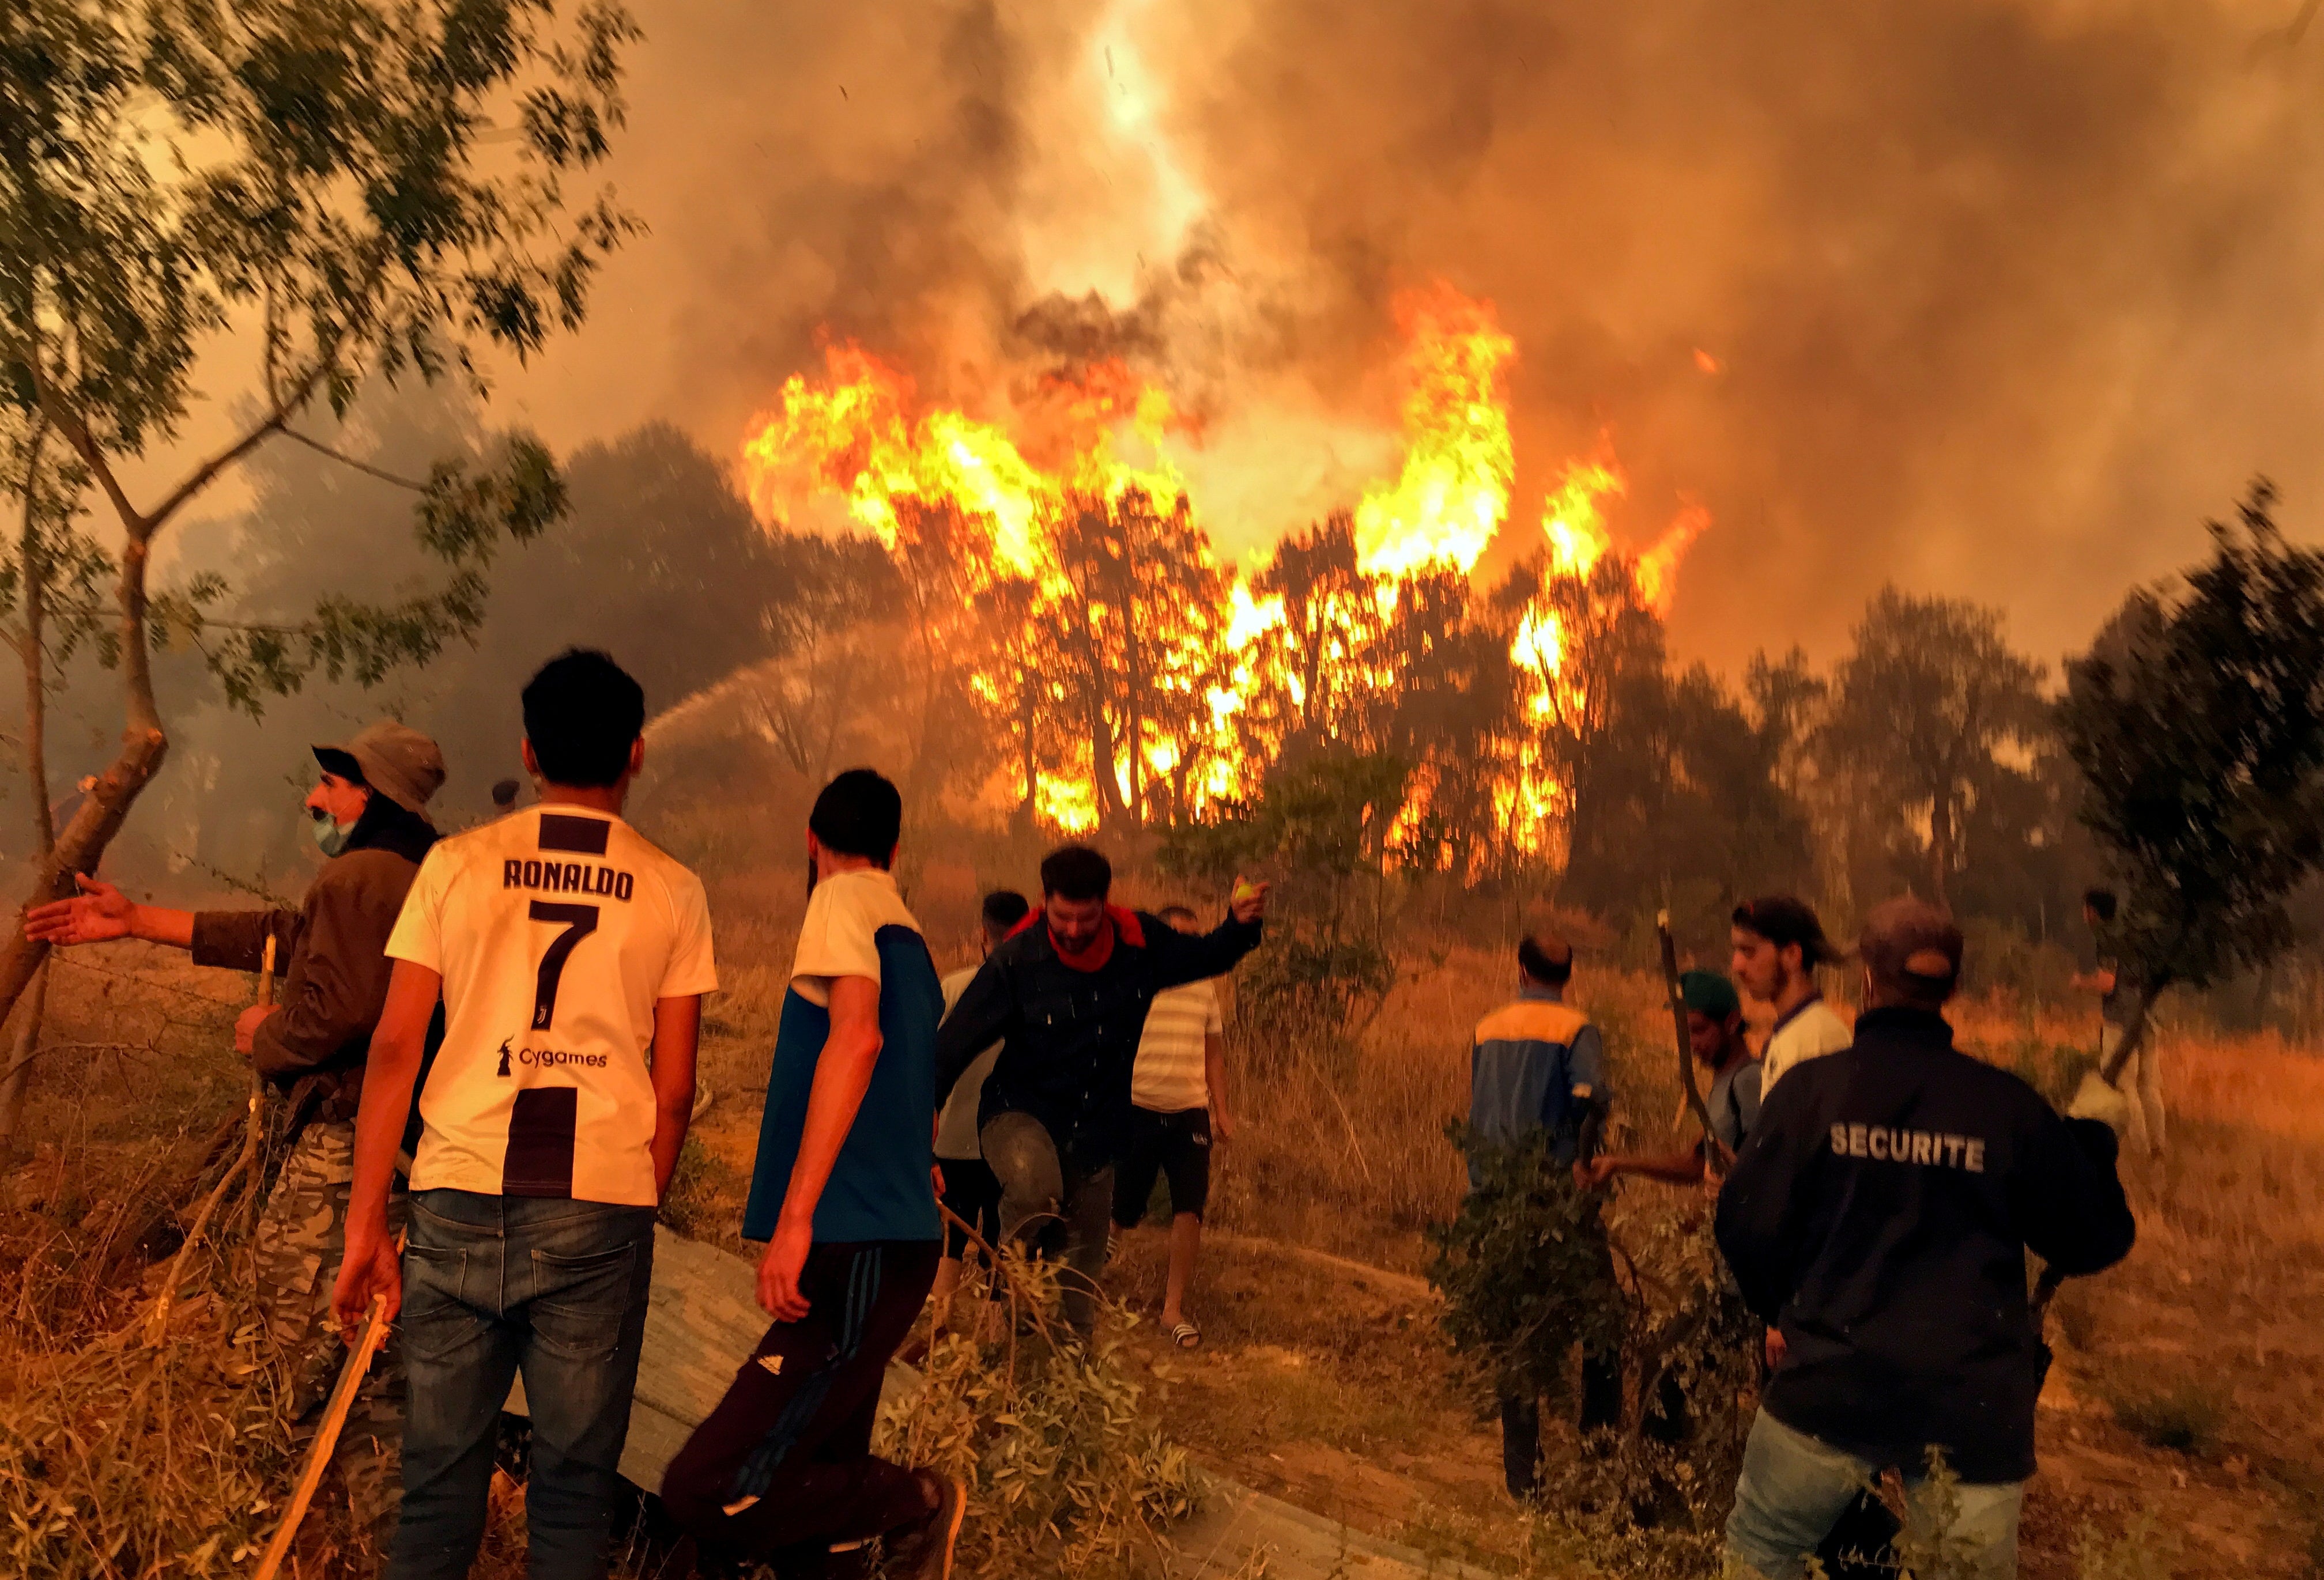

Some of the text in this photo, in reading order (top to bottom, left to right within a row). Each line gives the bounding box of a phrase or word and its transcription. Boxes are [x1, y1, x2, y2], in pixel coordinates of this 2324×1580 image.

[504, 859, 634, 902] RONALDO
[528, 900, 599, 1031] 7
[519, 1048, 608, 1068] Cygames
[1830, 1122, 1986, 1173] SECURITE
